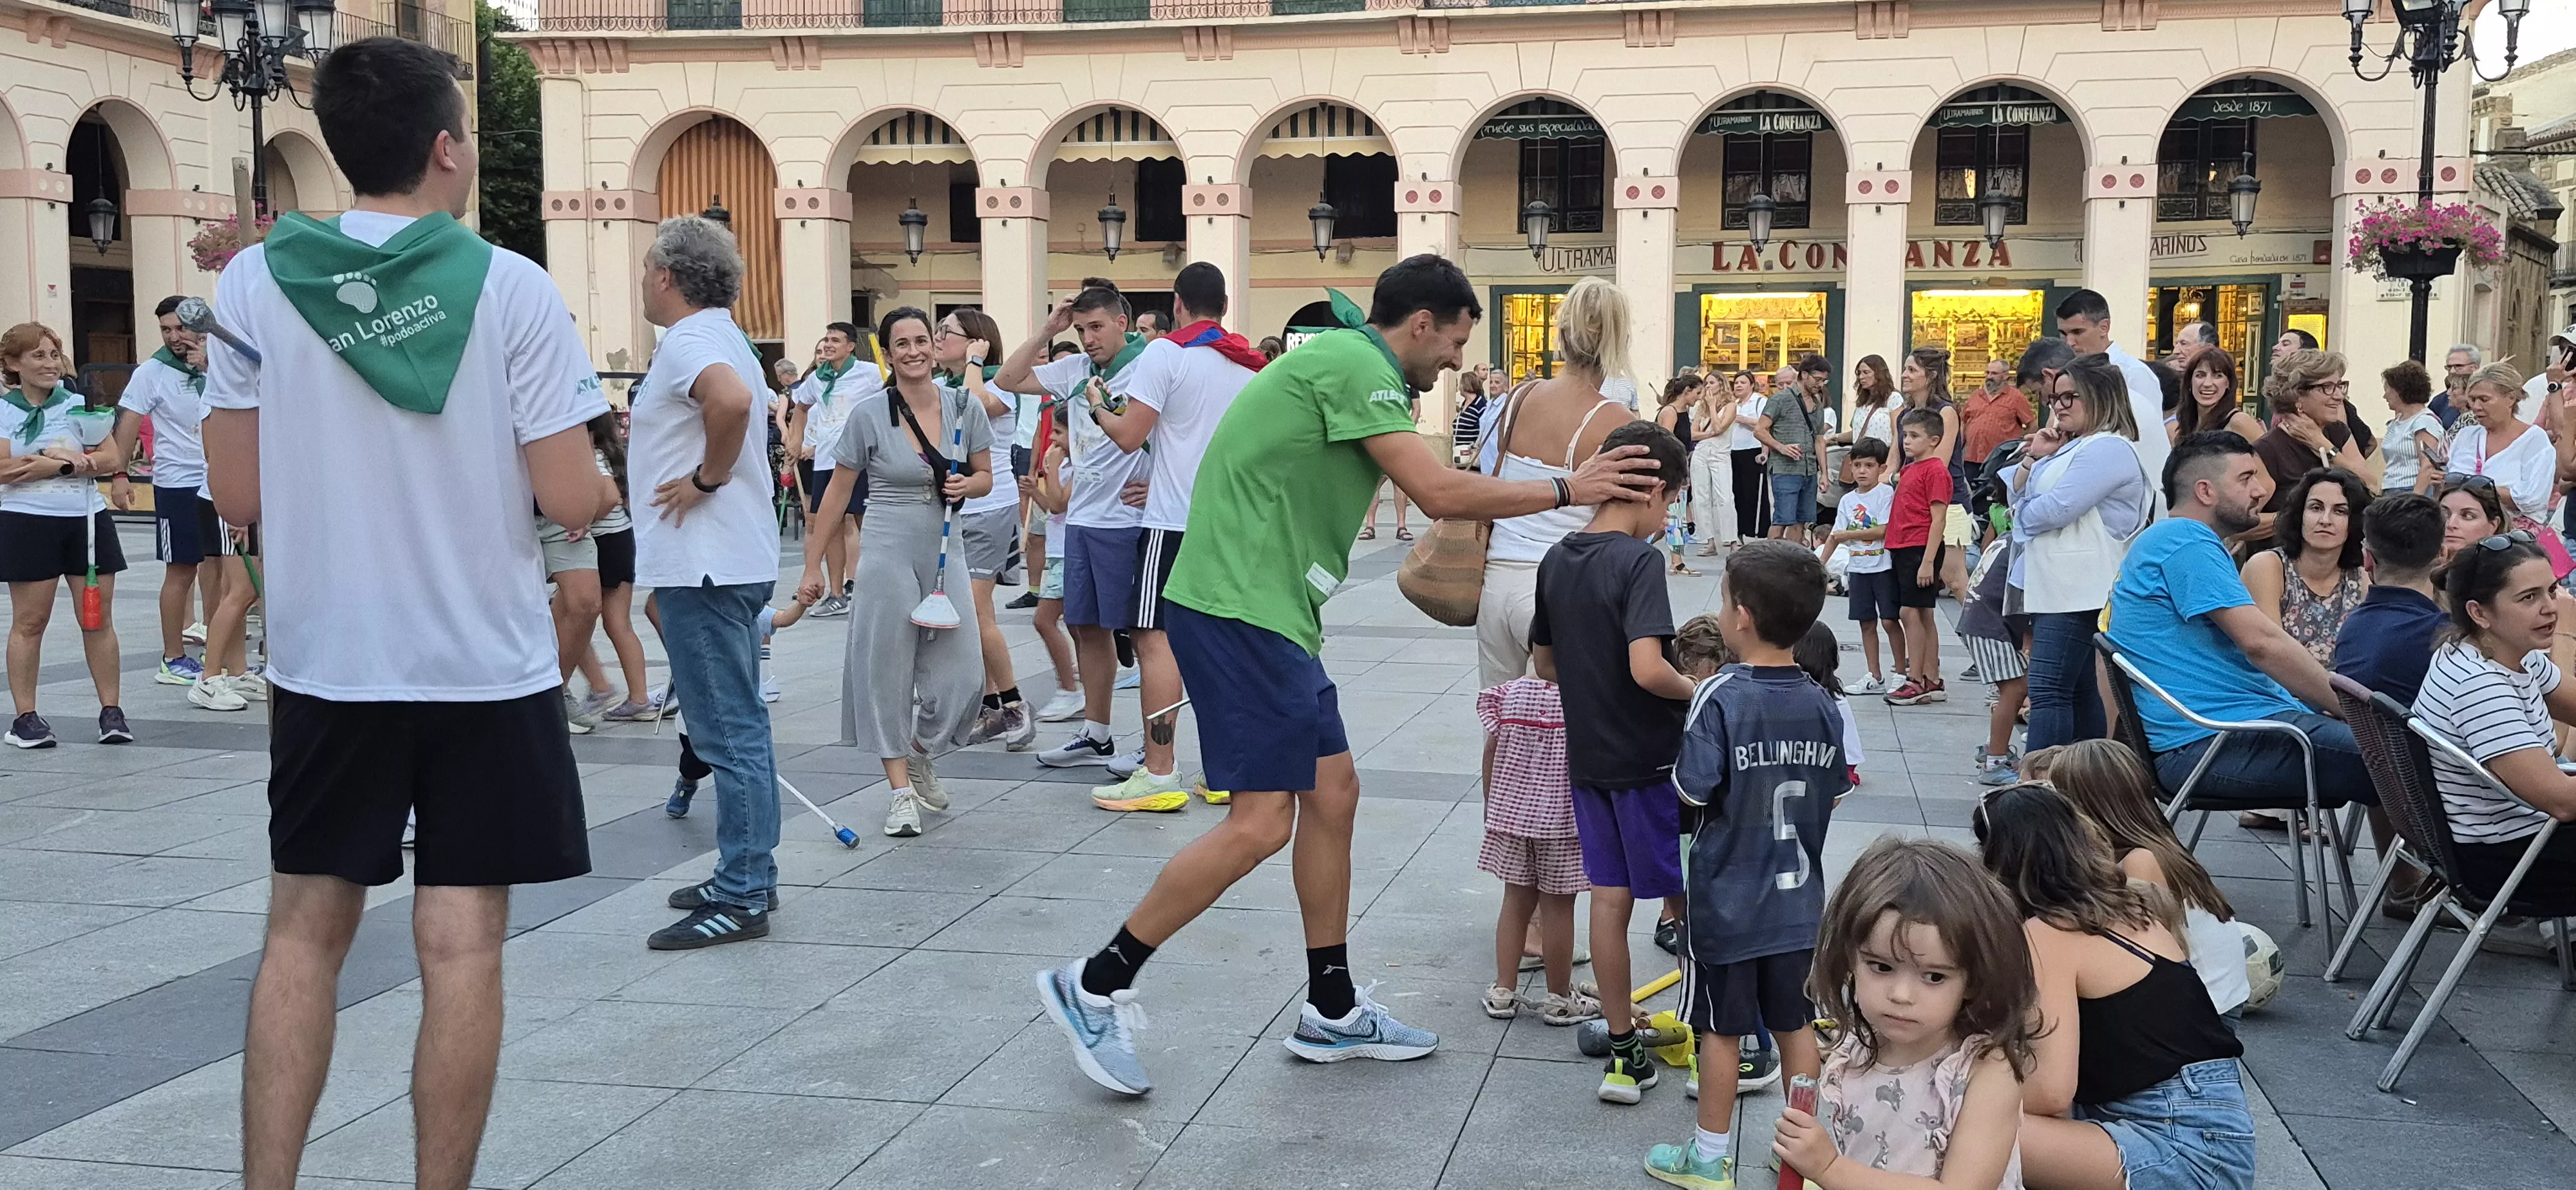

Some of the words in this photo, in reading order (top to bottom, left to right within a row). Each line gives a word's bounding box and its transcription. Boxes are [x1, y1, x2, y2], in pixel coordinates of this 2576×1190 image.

[1992, 106, 2003, 123] LA
[2007, 106, 2057, 122] CONFIANZA
[2213, 99, 2243, 113] desde
[2249, 100, 2271, 113] 1871
[1518, 124, 1534, 133] sus
[1759, 113, 1771, 131] LA
[1774, 113, 1822, 131] CONFIANZA
[1543, 246, 1616, 272] ULTRAMA
[1712, 241, 1761, 272] LA
[328, 332, 355, 352] an
[355, 295, 439, 341] Lorenzo
[380, 310, 447, 348] #podoactiva
[1773, 780, 1810, 890] 5
